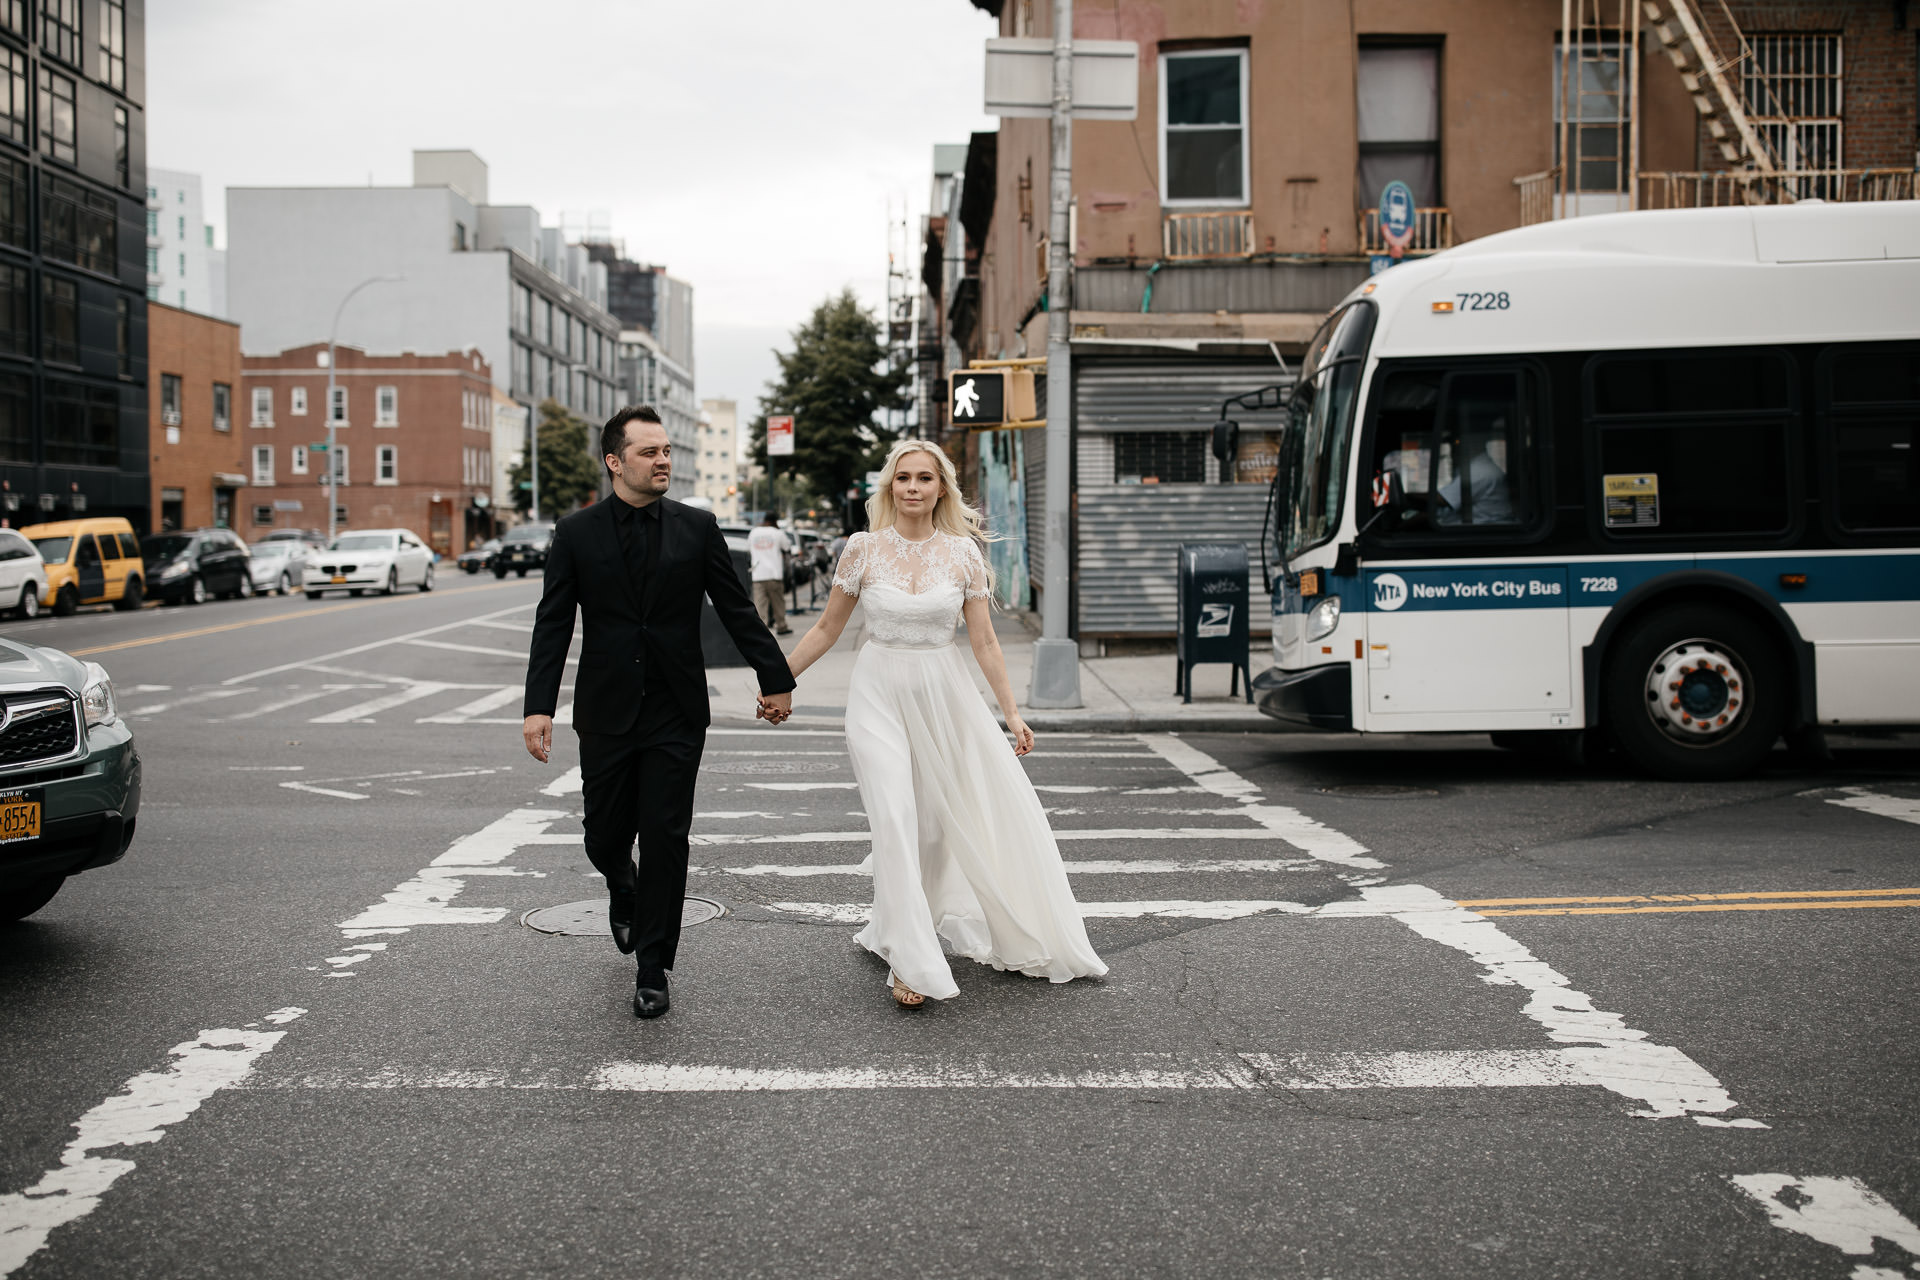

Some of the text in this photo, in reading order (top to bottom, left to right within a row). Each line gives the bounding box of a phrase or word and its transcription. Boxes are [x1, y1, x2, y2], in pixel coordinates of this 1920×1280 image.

[1456, 291, 1510, 311] 7228
[1412, 580, 1561, 598] New York City Bus
[1580, 577, 1617, 592] 7228
[4, 804, 36, 832] 8554
